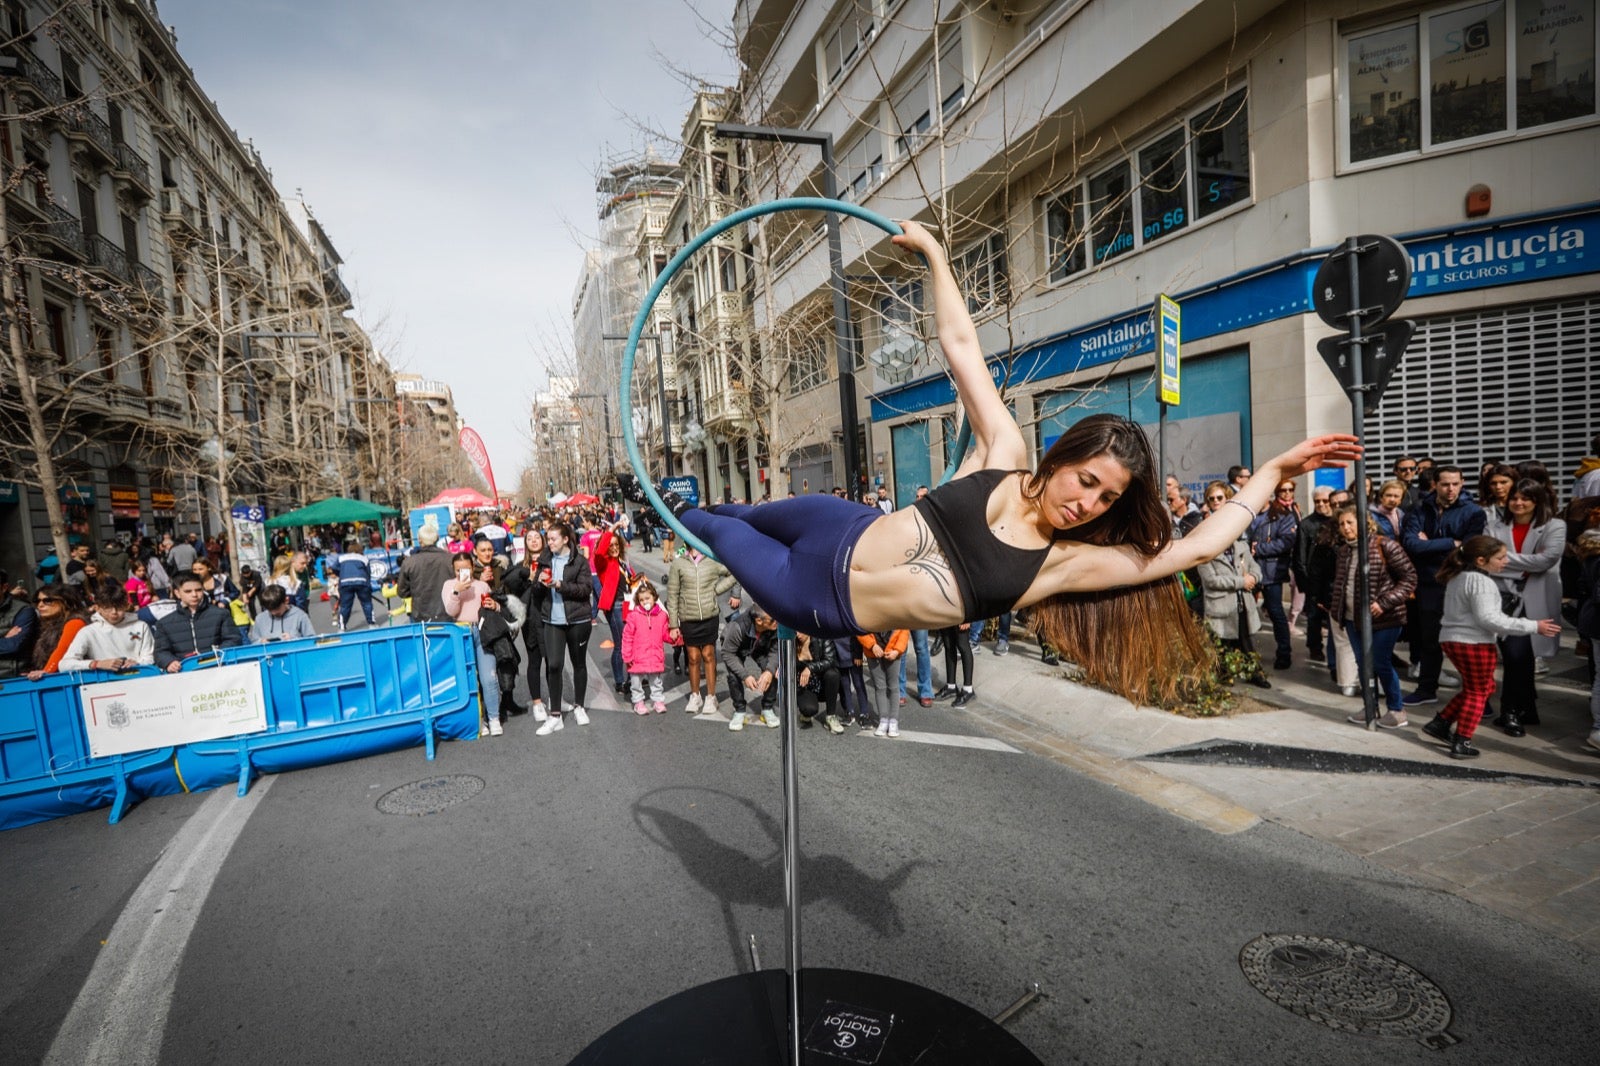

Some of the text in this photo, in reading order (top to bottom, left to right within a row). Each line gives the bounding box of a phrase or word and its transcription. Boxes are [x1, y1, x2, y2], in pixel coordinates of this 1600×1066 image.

[1523, 14, 1583, 35] ALHAMBRA
[1144, 224, 1161, 239] en
[1163, 207, 1184, 229] SG
[1443, 264, 1508, 284] SEGUROS
[191, 687, 246, 703] GRANADA
[823, 1015, 881, 1038] charlot
